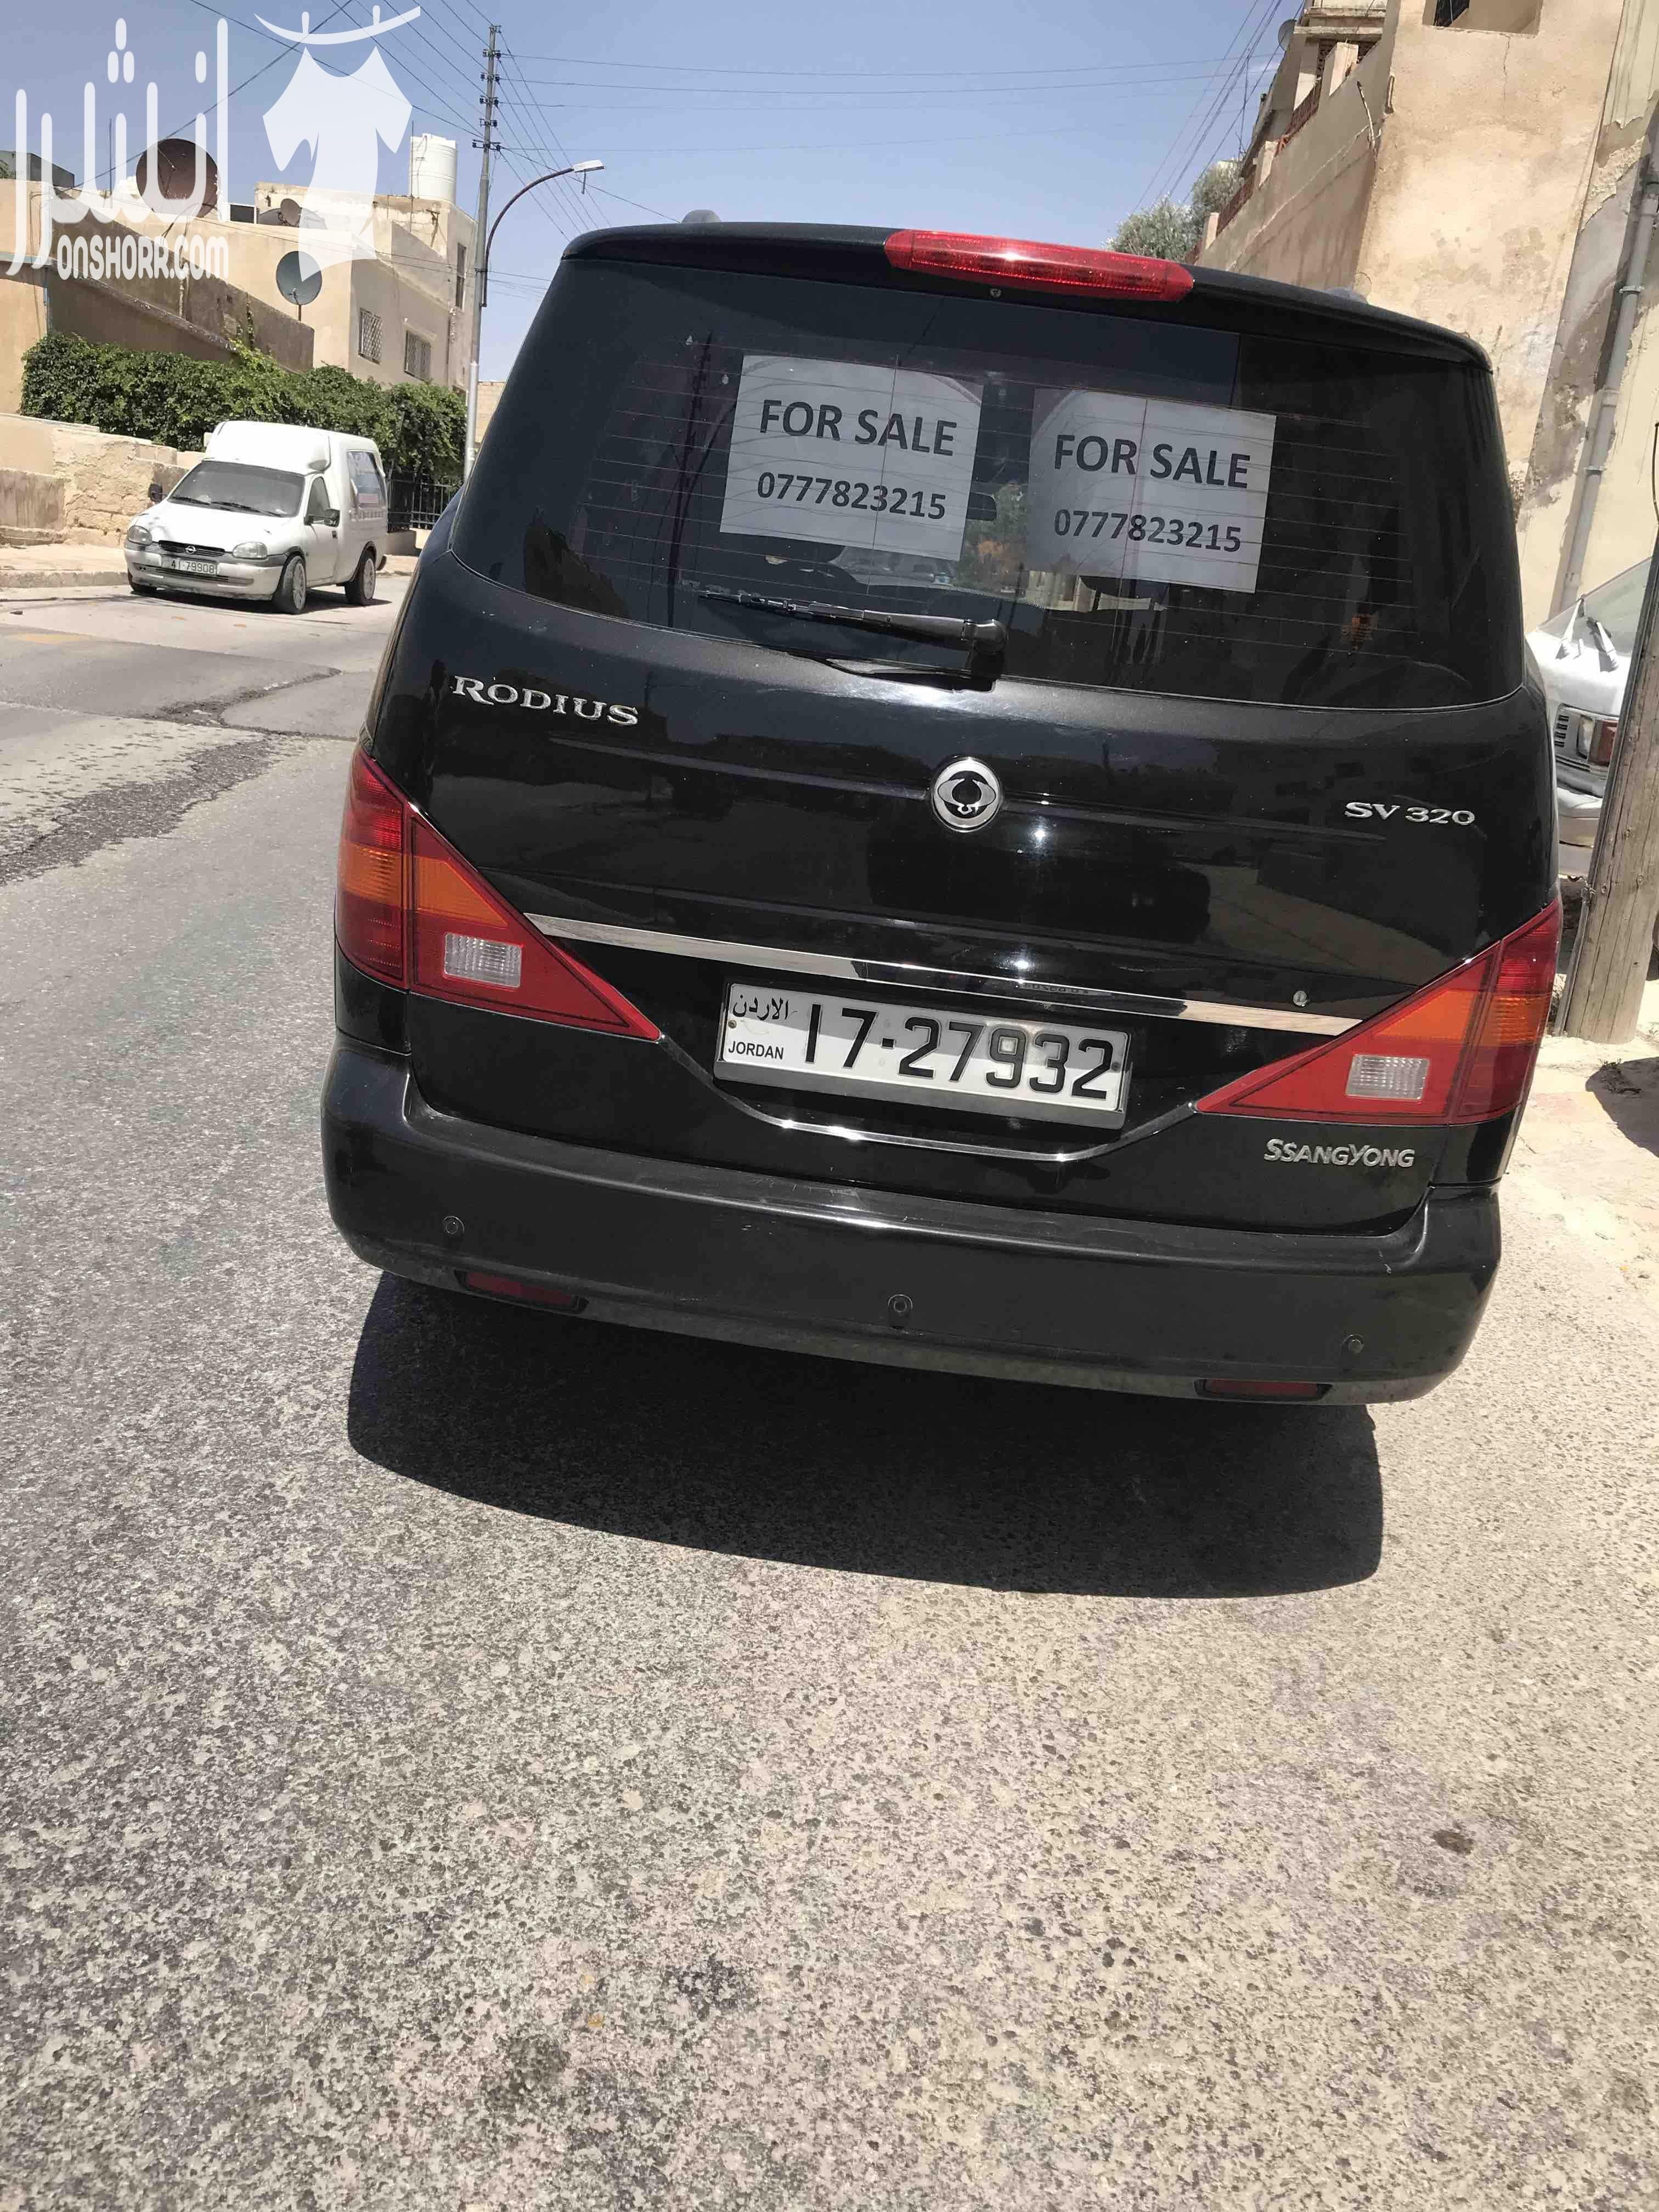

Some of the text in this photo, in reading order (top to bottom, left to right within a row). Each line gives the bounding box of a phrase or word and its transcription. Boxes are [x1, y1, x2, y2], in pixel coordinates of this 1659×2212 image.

[760, 399, 957, 456] FOR SALE
[1054, 434, 1251, 489] FOR SALE
[757, 472, 946, 520] 0777823215
[1053, 509, 1242, 552] 0777823215
[452, 675, 638, 726] RODIUS
[1344, 802, 1475, 826] SV 320
[732, 994, 789, 1022] الاردن
[728, 1040, 784, 1060] JORDAN
[804, 1003, 1114, 1100] 17-27932
